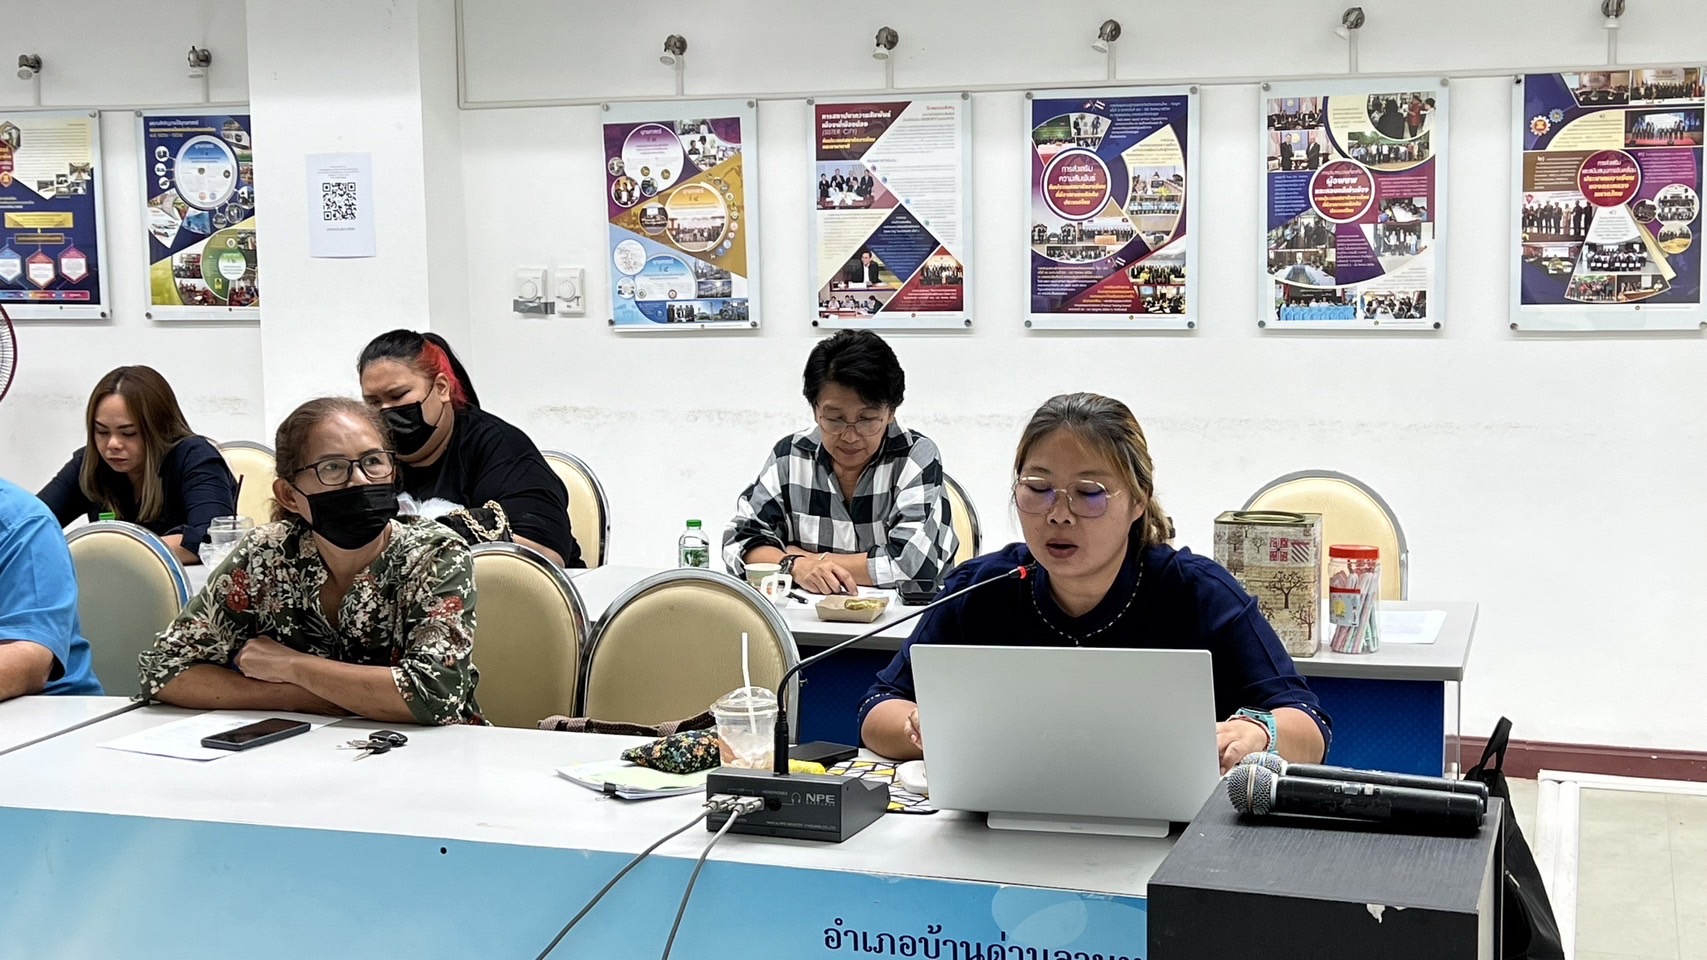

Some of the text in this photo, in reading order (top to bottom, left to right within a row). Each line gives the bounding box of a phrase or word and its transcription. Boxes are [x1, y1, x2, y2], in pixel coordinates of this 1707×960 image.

[842, 128, 858, 136] CITY)
[1061, 164, 1094, 173] การส่งเสริม
[1058, 172, 1097, 182] ความสัมพันธ์
[805, 792, 836, 804] NPE
